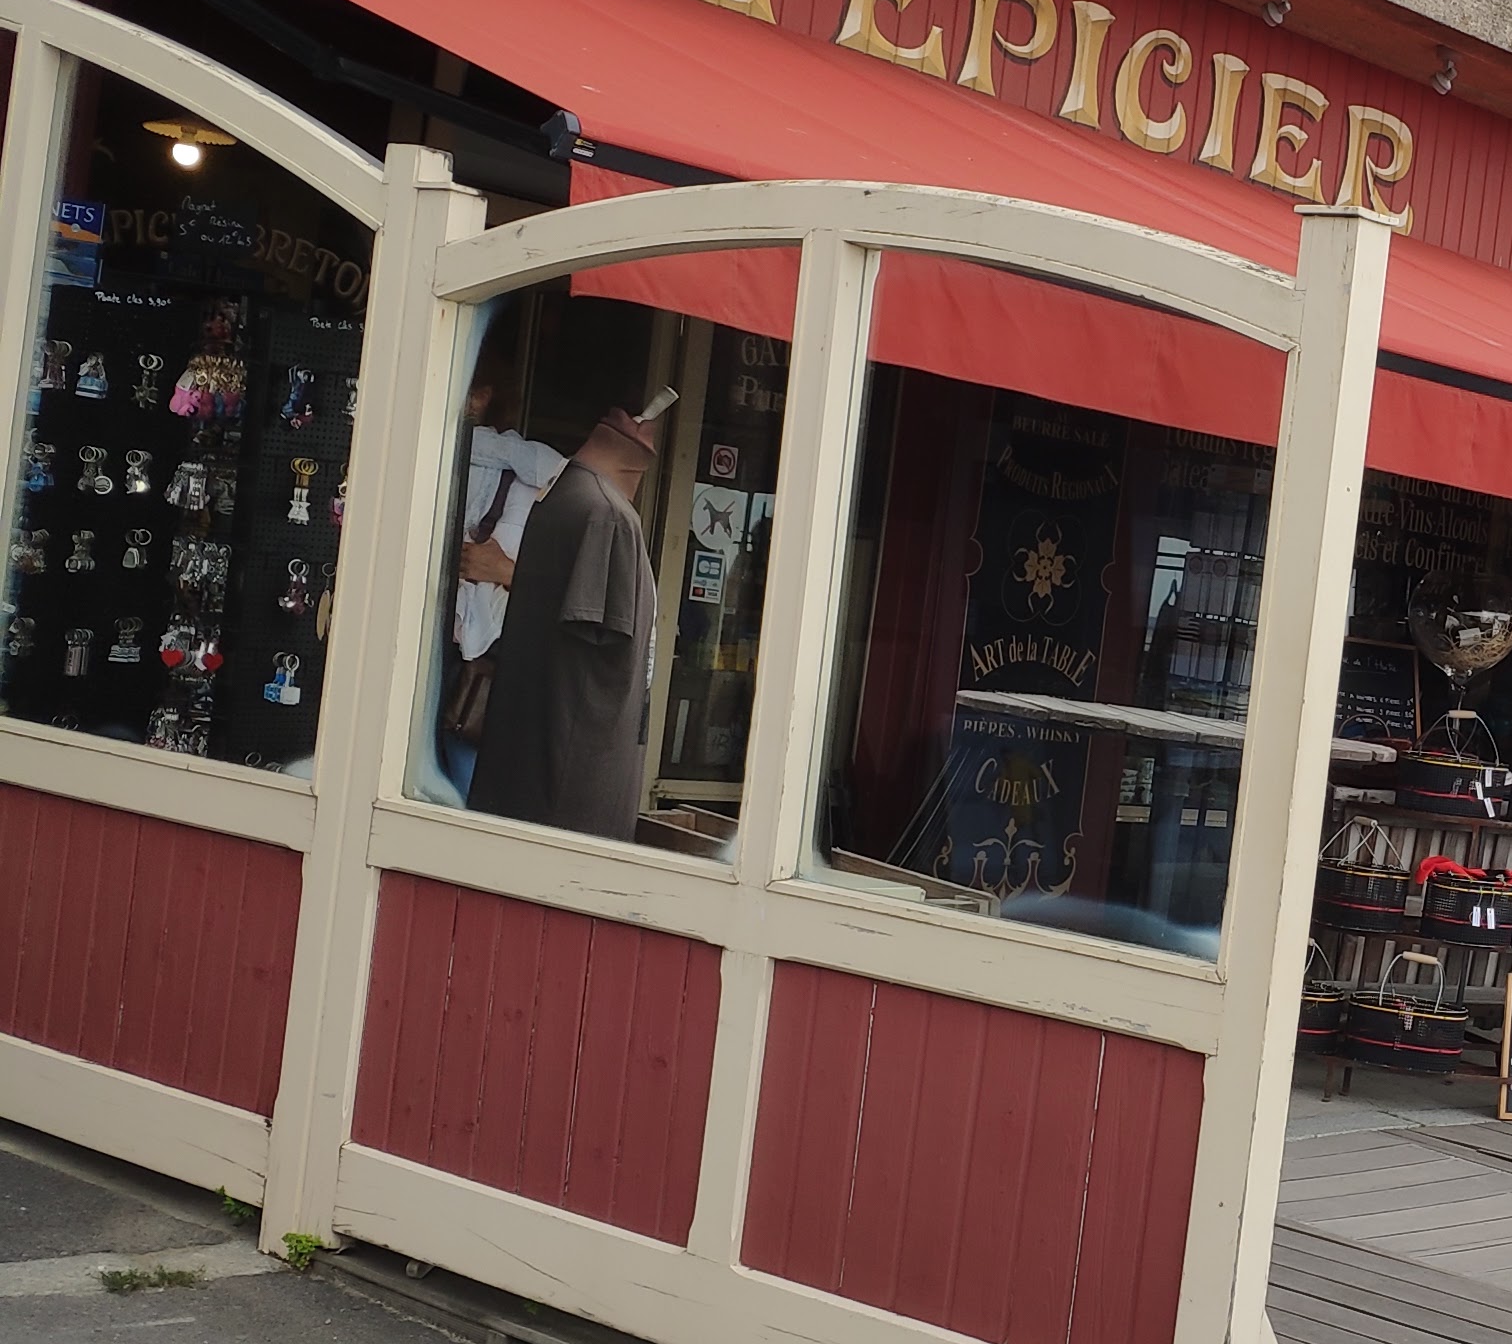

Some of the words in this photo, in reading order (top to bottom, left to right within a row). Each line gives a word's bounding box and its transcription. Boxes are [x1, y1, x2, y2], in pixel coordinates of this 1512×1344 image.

[970, 638, 1005, 683] ART
[1008, 634, 1025, 664] de
[1026, 633, 1039, 663] la
[1041, 636, 1097, 688] TABLE
[974, 757, 1061, 807] CADEAUX
